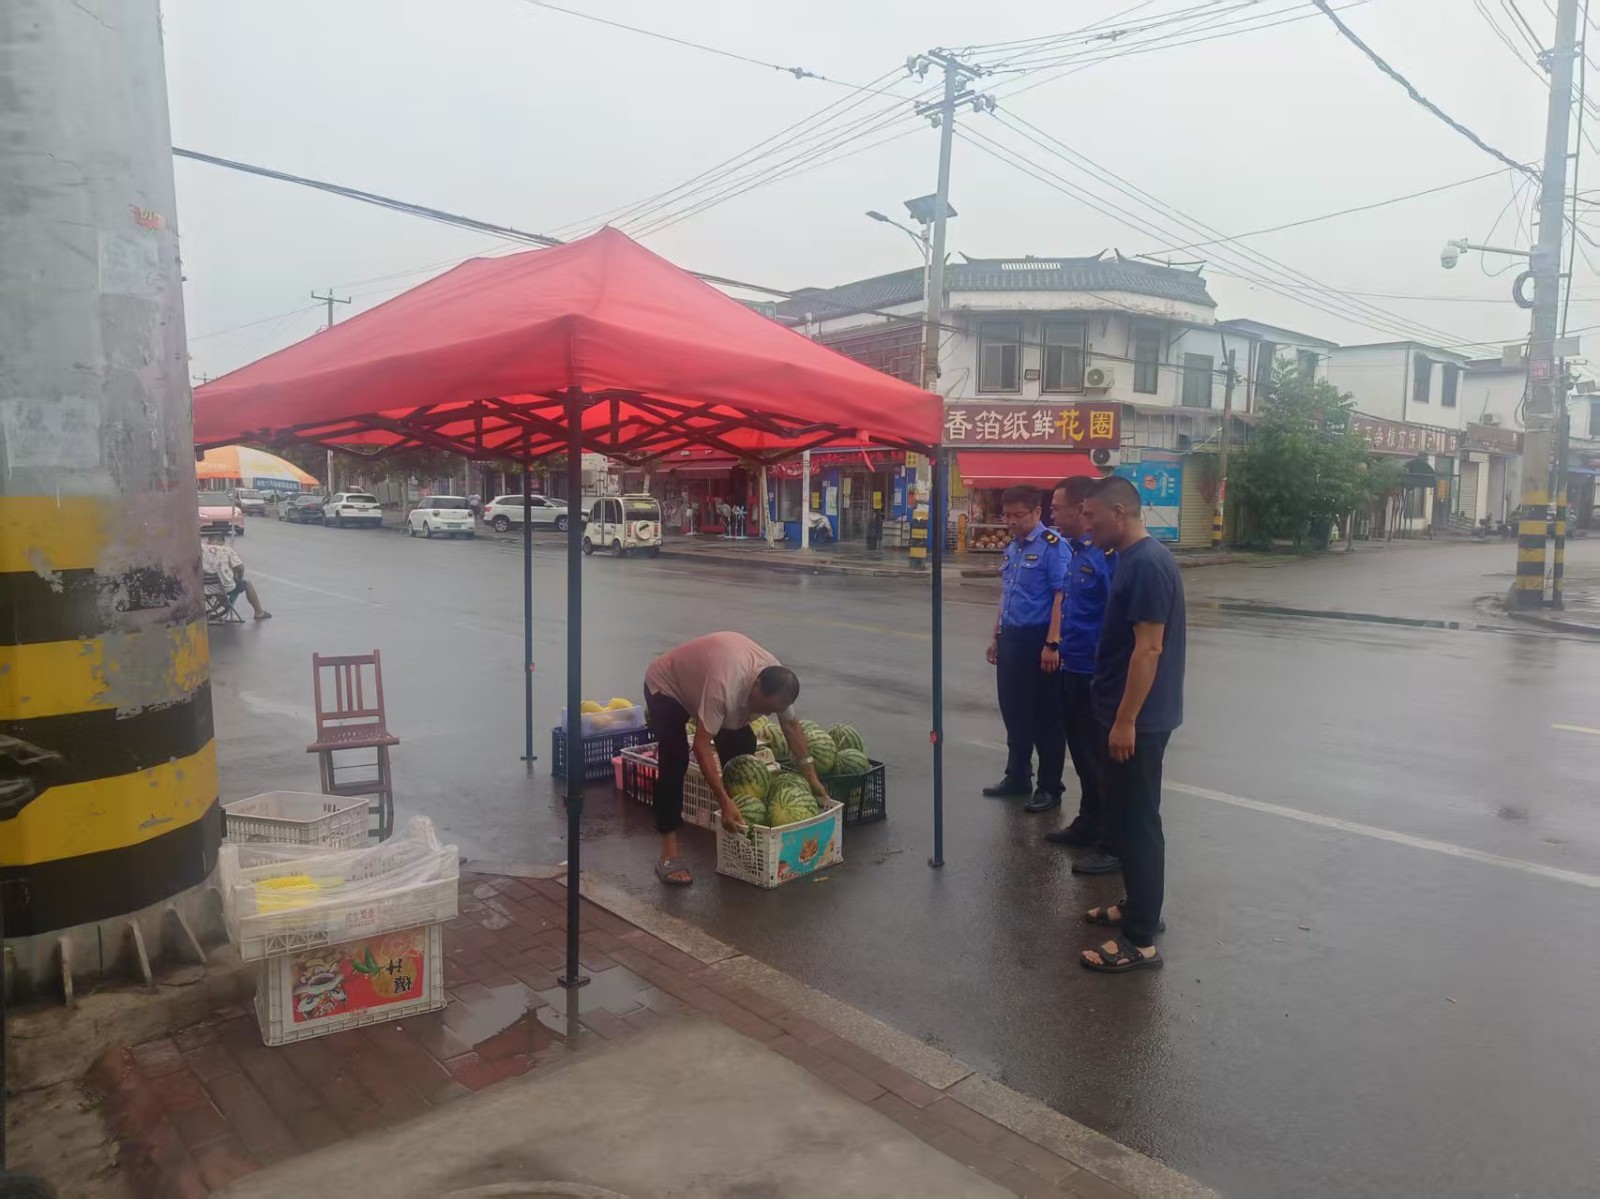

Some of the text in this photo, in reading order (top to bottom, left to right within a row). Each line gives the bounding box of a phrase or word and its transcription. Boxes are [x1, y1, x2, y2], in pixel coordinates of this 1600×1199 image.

[943, 409, 1115, 441] 香箔纸鲜花圈
[386, 959, 413, 994] 爆汁
